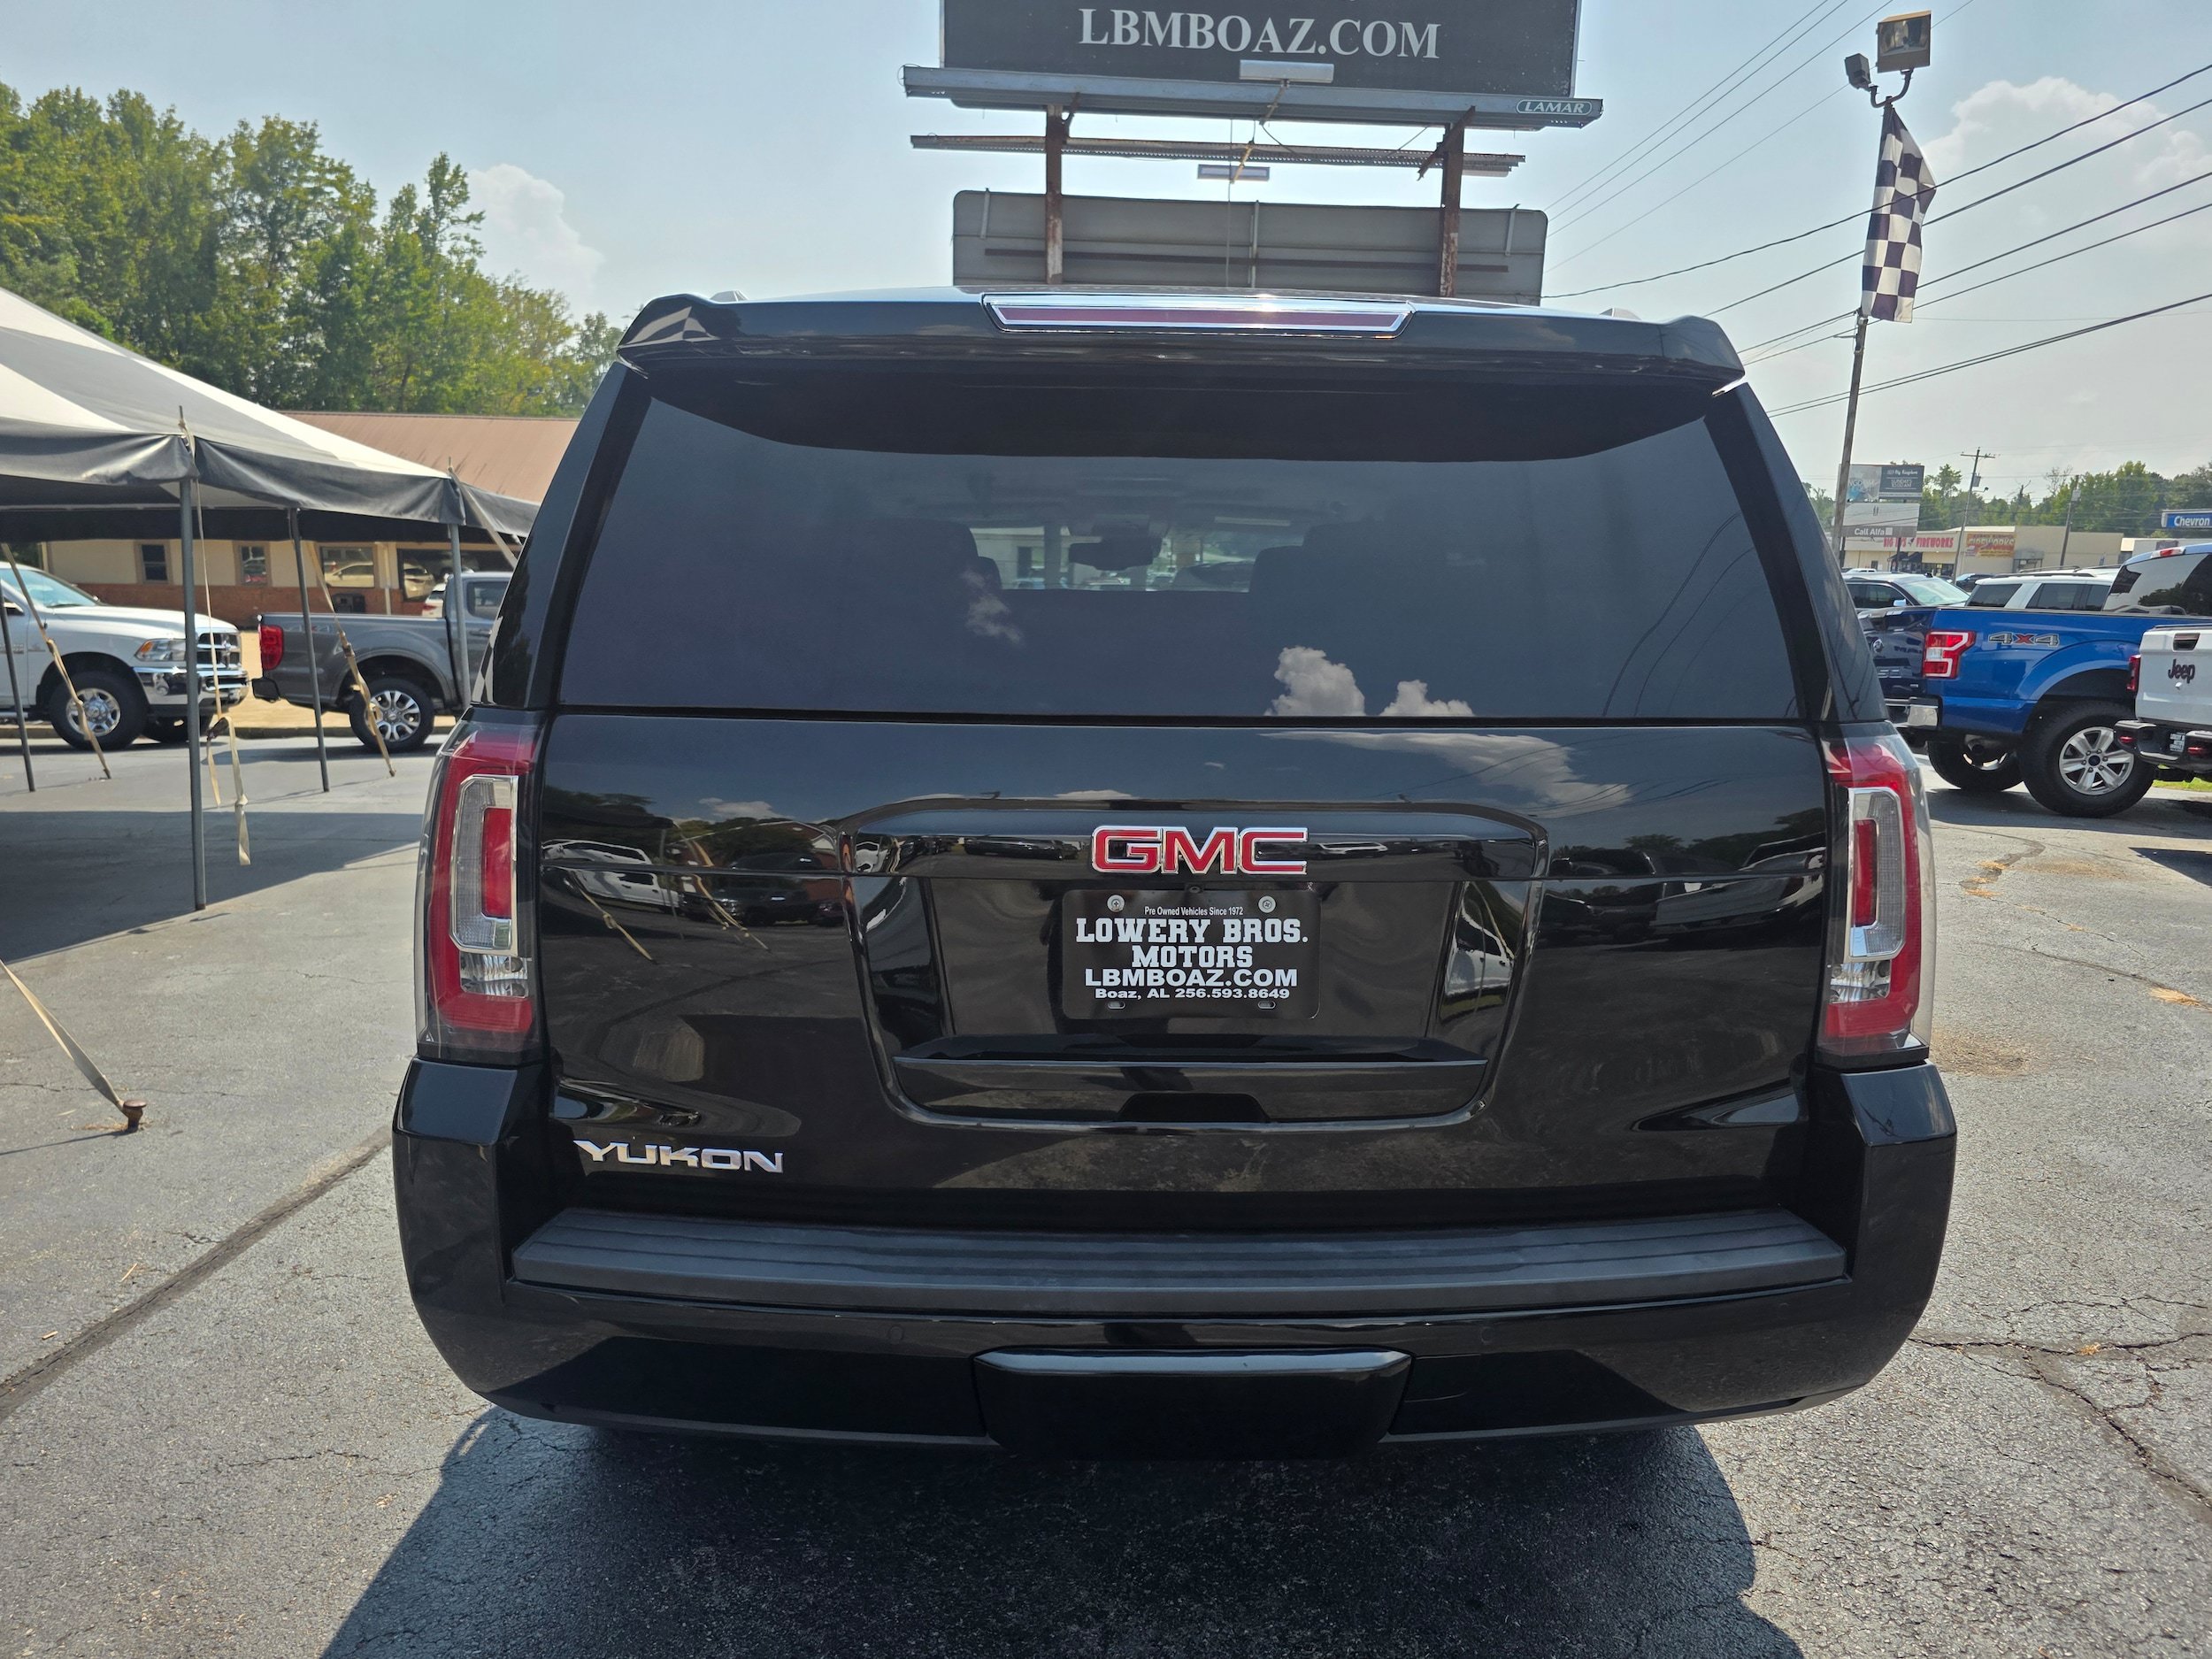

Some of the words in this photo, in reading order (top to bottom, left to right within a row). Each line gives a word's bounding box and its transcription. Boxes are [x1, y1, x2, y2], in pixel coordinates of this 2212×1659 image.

[1078, 8, 1442, 59] LBMBOAZ.COM
[1525, 102, 1585, 113] LAMAR
[2174, 515, 2210, 526] Chevron
[1916, 537, 1954, 548] FIREWORKS
[2168, 658, 2196, 684] Jeep
[1091, 826, 1309, 875] GMC
[1144, 907, 1156, 916] Pre
[1156, 907, 1179, 916] Owned
[1180, 907, 1208, 916] Vehicles
[1209, 907, 1227, 916] Since
[1228, 907, 1244, 916] 1972
[1076, 918, 1211, 943] LOWERY
[1223, 918, 1309, 943] BROS.
[1131, 945, 1253, 968] MOTORS
[1085, 968, 1298, 987] LBMBOAZ.COM
[1094, 988, 1142, 1000] Boaz,
[1147, 988, 1171, 999] AL
[1174, 988, 1290, 999] 256.593.8649
[572, 1140, 784, 1173] YUKON
